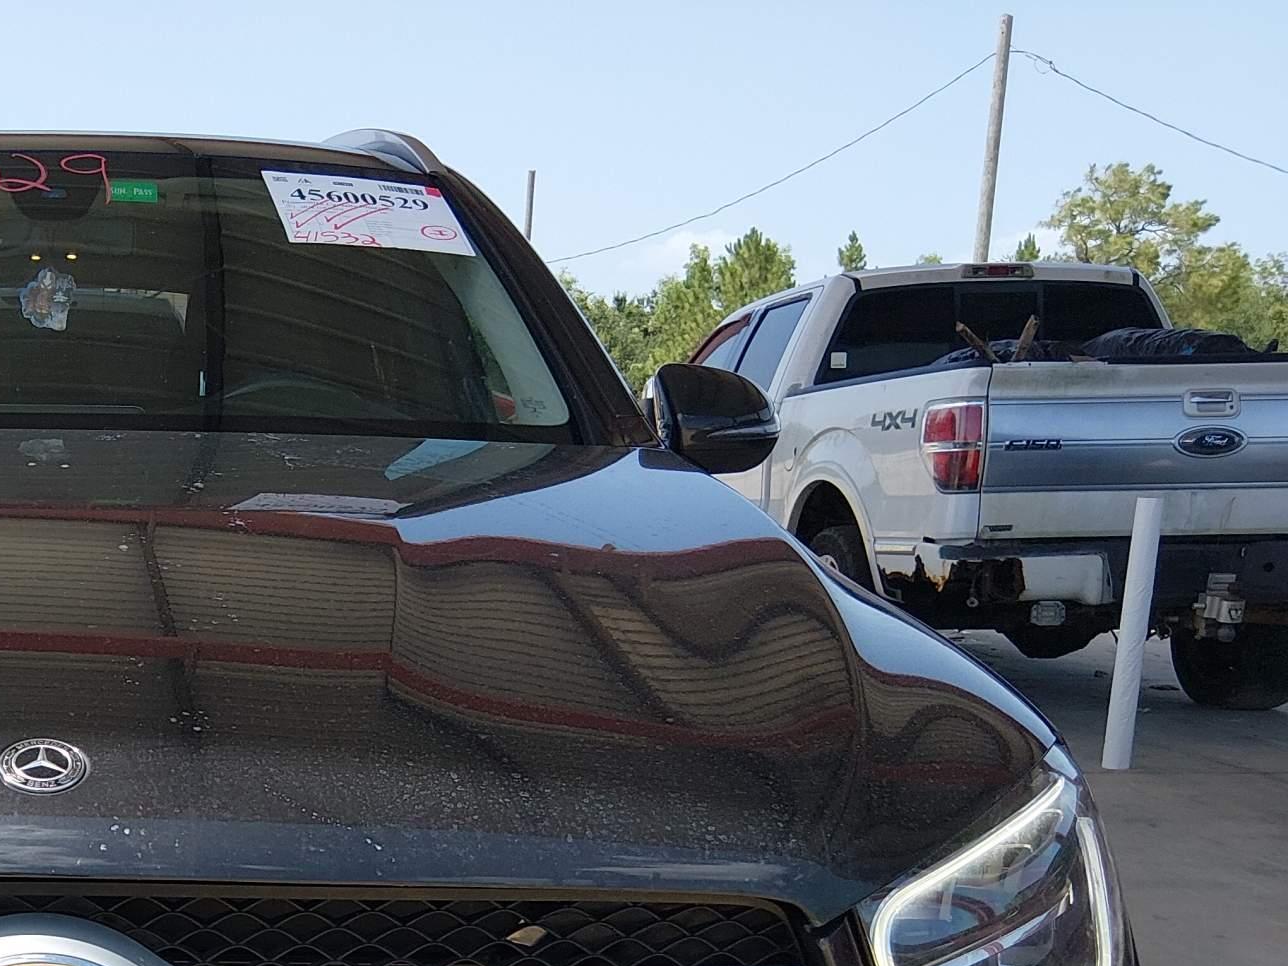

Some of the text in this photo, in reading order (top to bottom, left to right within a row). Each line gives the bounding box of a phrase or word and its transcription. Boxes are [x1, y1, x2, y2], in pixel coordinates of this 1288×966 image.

[133, 187, 153, 196] PASS
[290, 187, 429, 211] 45600529
[293, 230, 383, 248] 41532
[27, 780, 57, 788] BENZ
